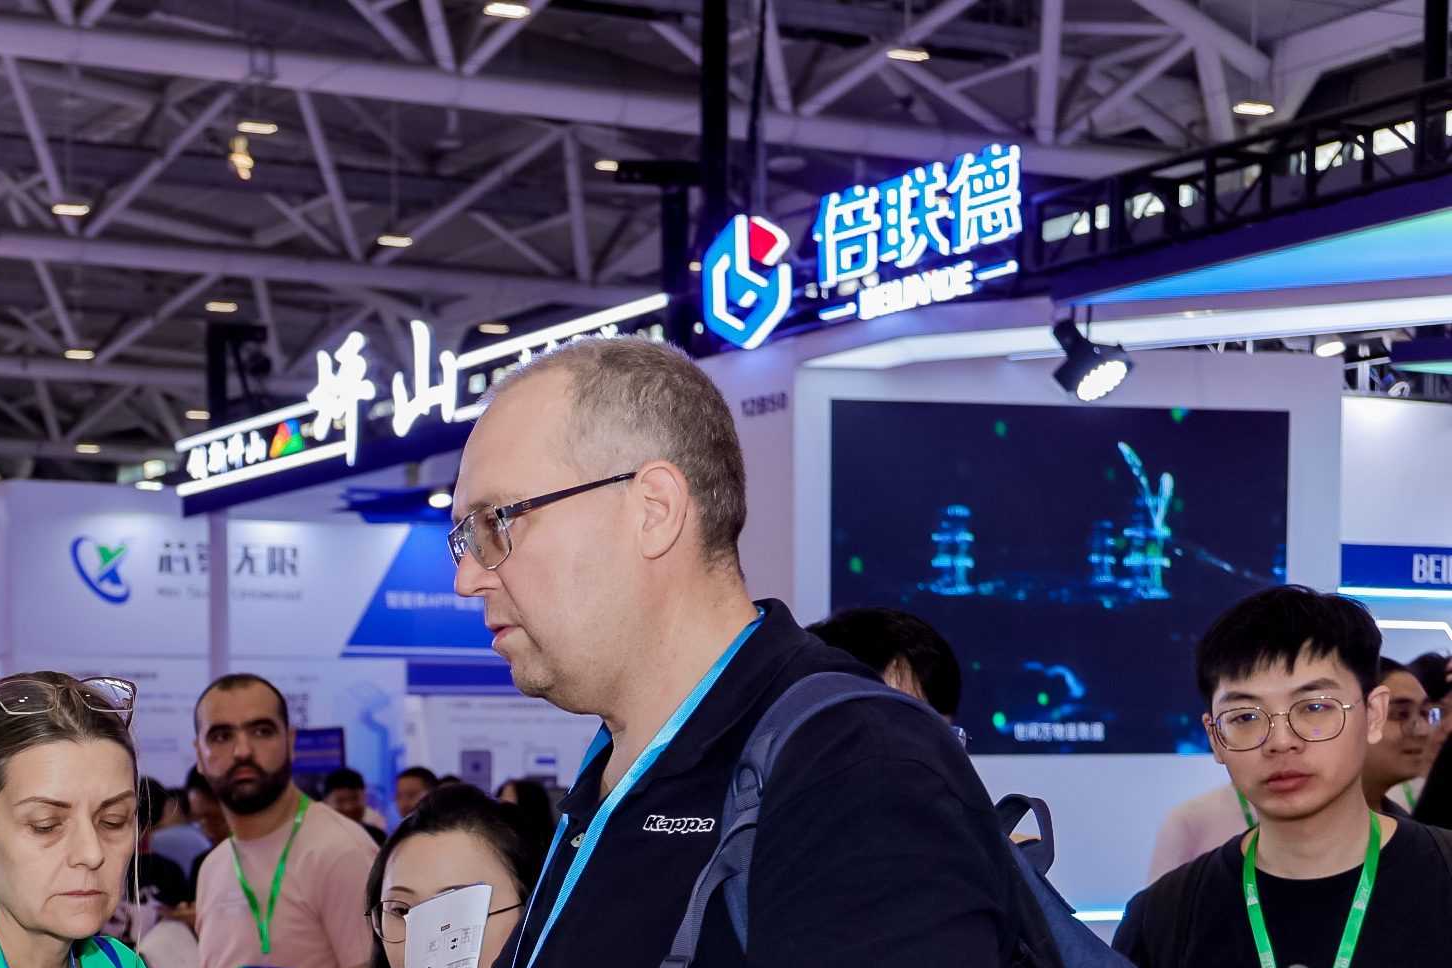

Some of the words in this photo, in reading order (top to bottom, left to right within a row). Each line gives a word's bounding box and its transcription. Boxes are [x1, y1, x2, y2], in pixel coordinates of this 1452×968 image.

[812, 143, 1023, 289] 倍联德
[643, 815, 715, 834] Kappa
